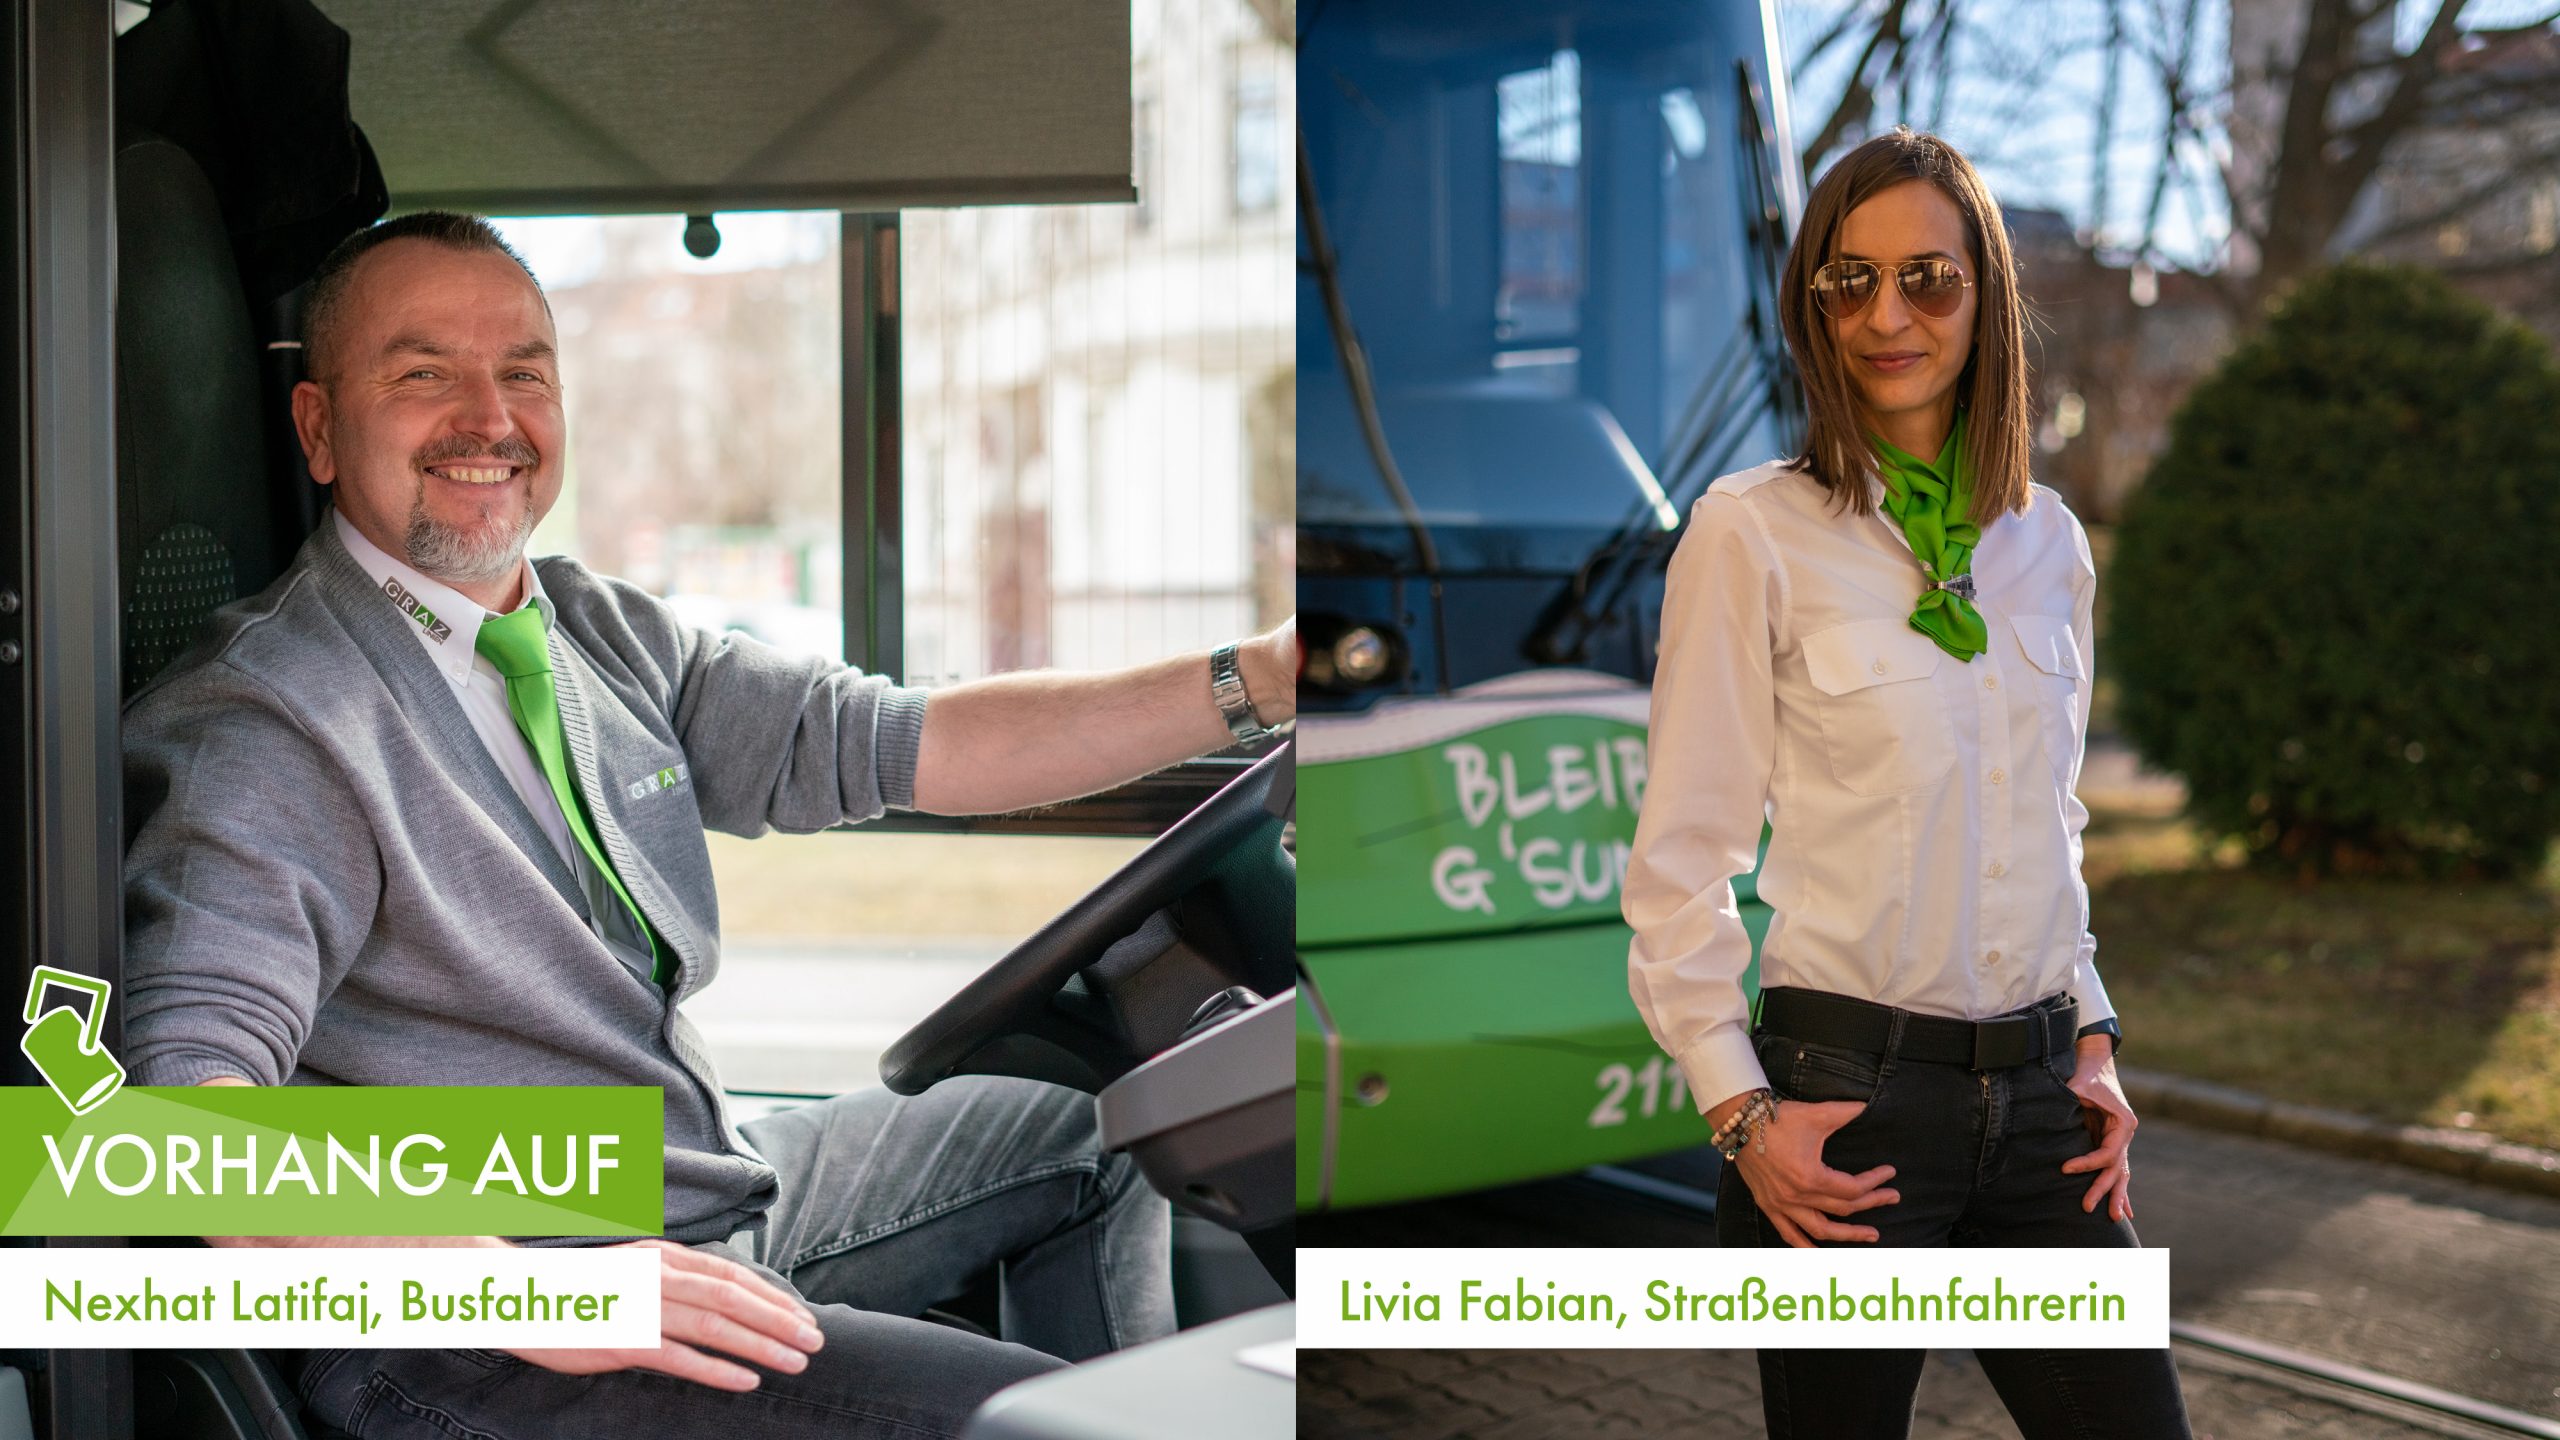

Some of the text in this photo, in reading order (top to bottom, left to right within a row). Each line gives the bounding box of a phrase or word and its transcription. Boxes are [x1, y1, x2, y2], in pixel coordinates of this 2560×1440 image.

[383, 579, 450, 640] GRAZ
[630, 763, 687, 799] GRAZ
[1445, 737, 1648, 828] BLEIB
[1589, 1056, 1687, 1128] 211
